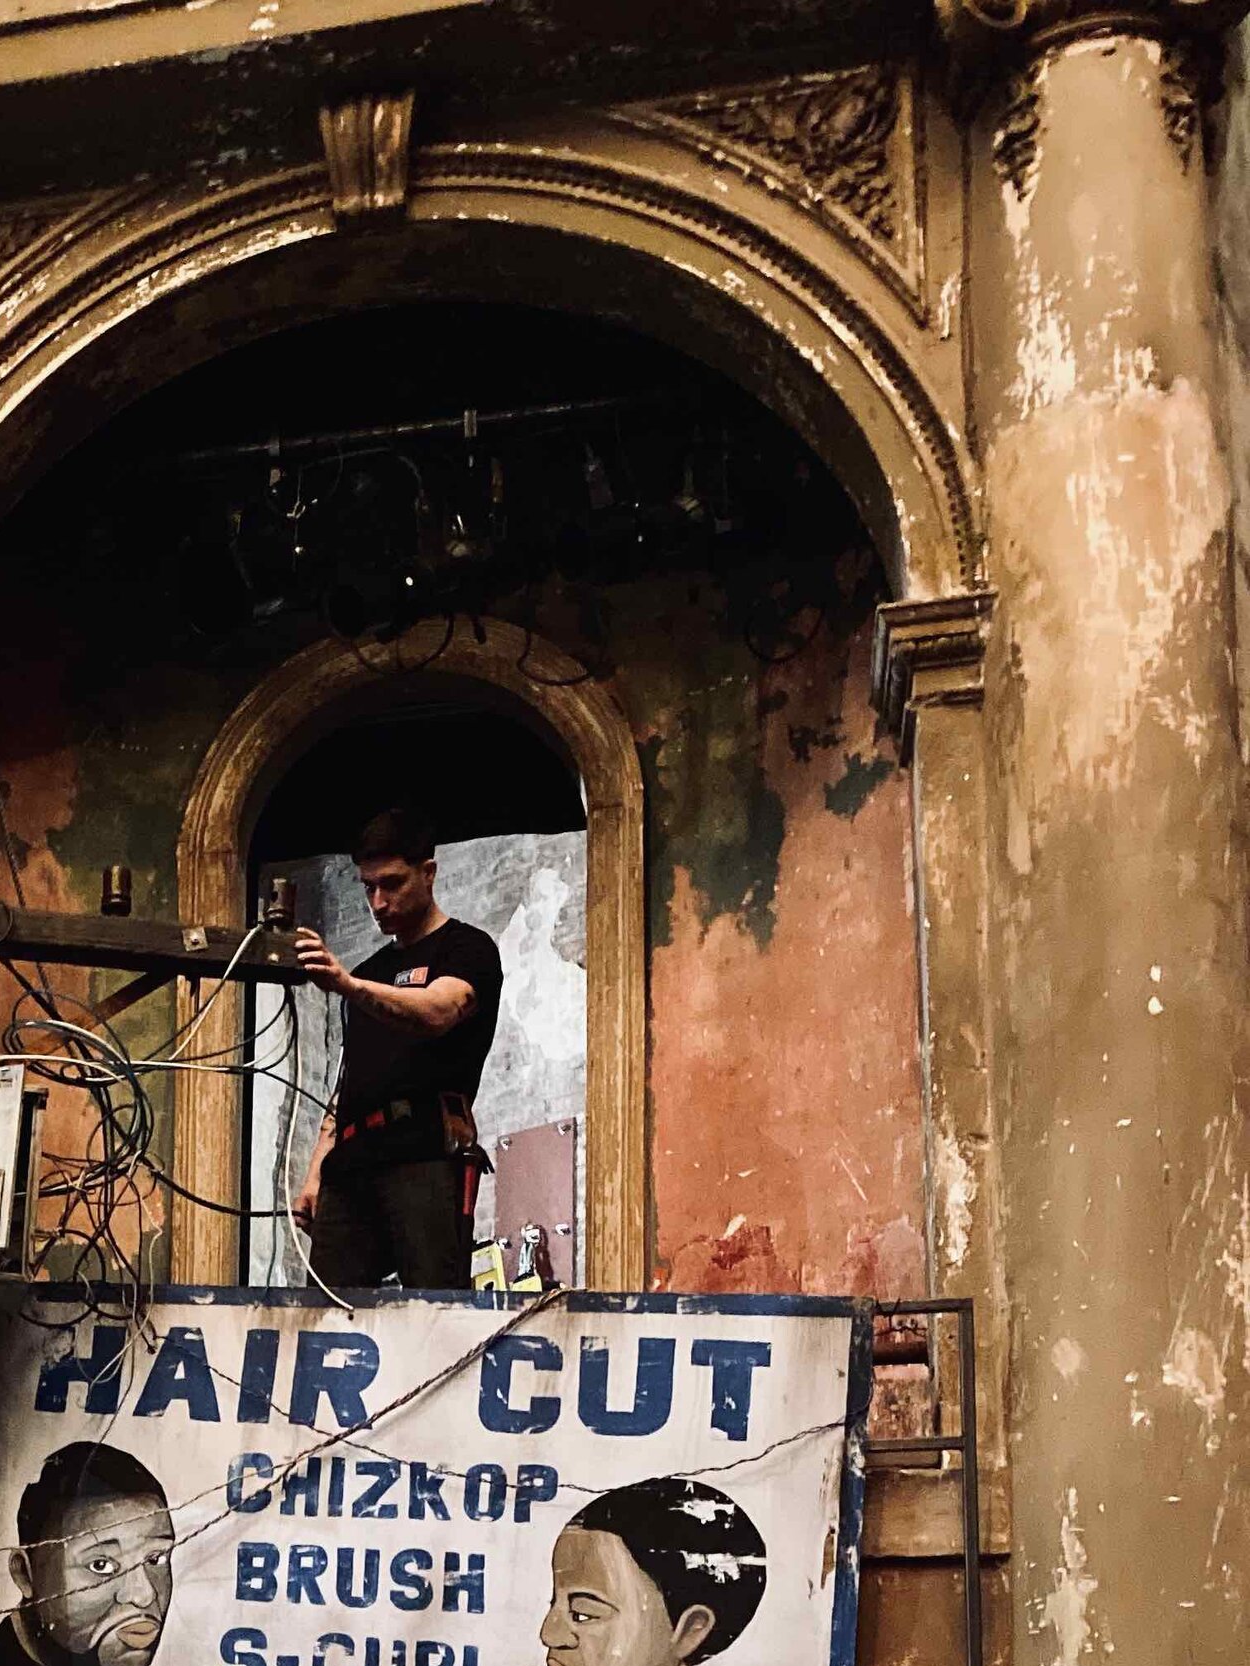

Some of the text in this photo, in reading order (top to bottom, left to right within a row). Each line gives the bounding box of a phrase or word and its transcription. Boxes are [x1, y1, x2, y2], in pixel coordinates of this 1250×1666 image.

[34, 1325, 772, 1443] HAIR CUT
[225, 1451, 559, 1525] CHIZKOP
[235, 1541, 486, 1616] BRUSH
